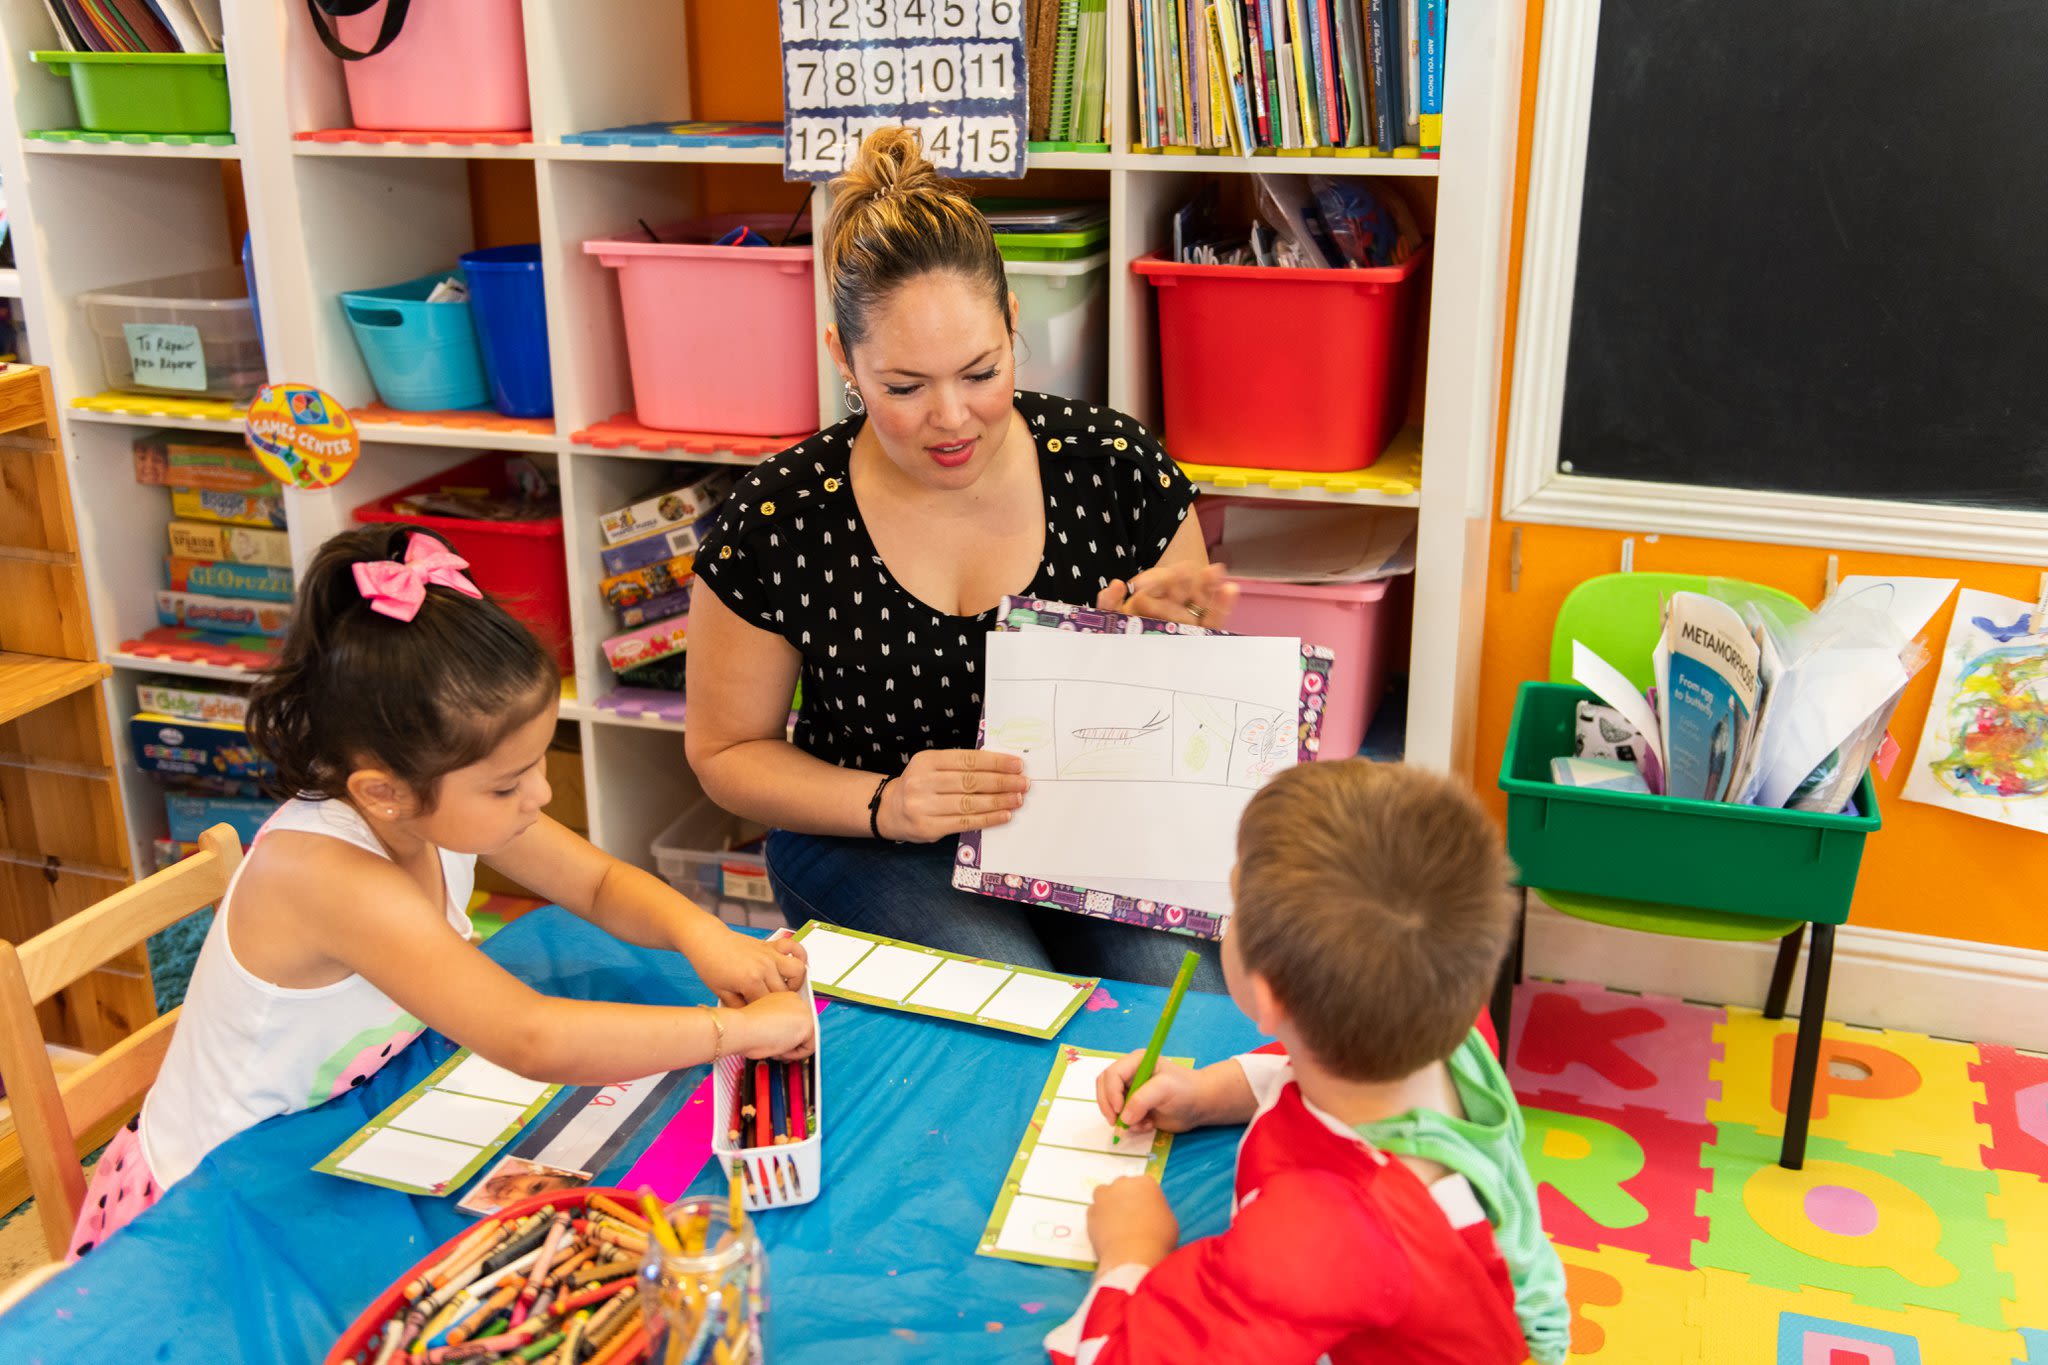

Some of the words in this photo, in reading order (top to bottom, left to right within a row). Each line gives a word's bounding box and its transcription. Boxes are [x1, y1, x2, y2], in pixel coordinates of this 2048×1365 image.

[792, 0, 805, 29] 1
[829, 0, 850, 29] 2
[866, 0, 888, 29] 3
[904, 0, 926, 26] 4
[943, 0, 965, 27] 5
[991, 0, 1013, 25] 6
[1427, 11, 1435, 37] ROBOT
[1427, 38, 1435, 55] AND
[797, 62, 818, 97] 7
[835, 61, 857, 97] 8
[873, 60, 895, 96] 9
[910, 57, 954, 93] 10
[970, 53, 1005, 88] 11
[1427, 57, 1435, 72] YOU
[1427, 74, 1435, 98] KNOW
[1427, 99, 1435, 107] IT
[796, 128, 838, 161] 12
[966, 129, 1011, 164] 15
[136, 333, 151, 353] To
[253, 419, 297, 441] GAMES
[297, 432, 353, 457] CENTER
[1674, 688, 1684, 700] to
[1685, 690, 1714, 719] butterfly
[1679, 673, 1701, 692] From
[1701, 687, 1714, 705] egg
[1770, 1033, 1922, 1121] P
